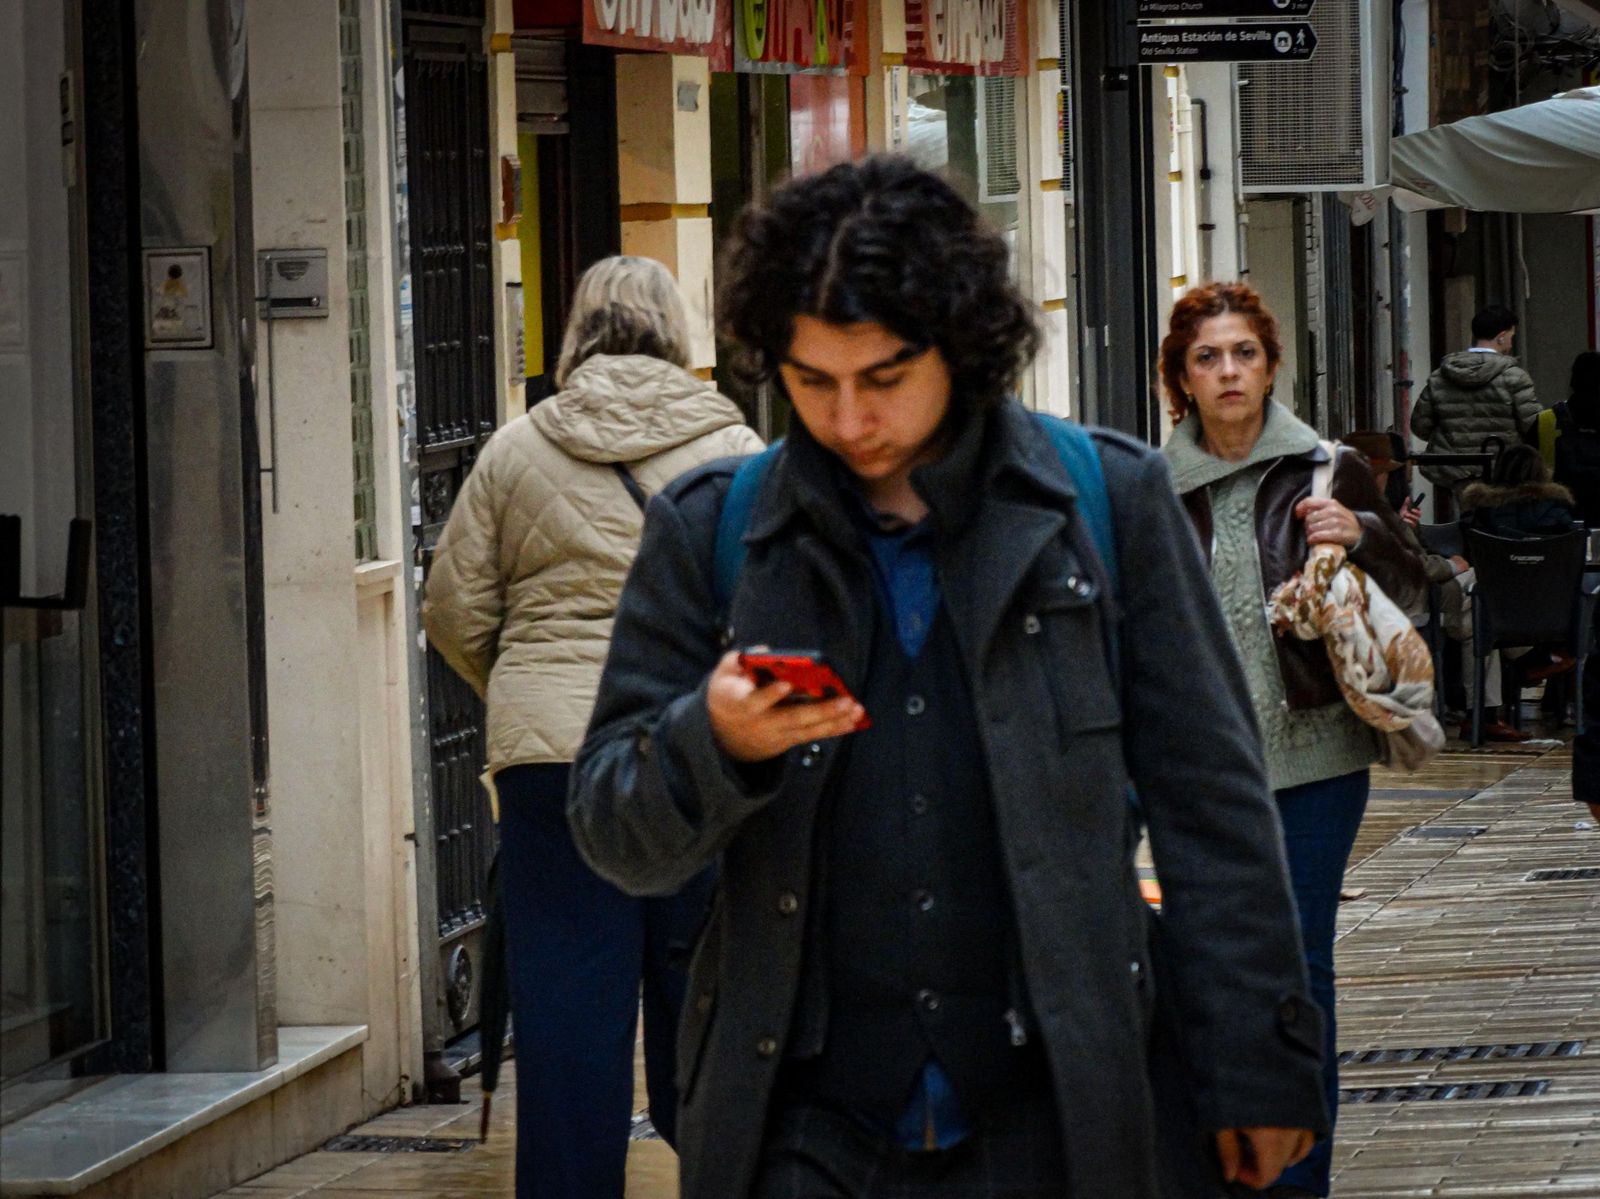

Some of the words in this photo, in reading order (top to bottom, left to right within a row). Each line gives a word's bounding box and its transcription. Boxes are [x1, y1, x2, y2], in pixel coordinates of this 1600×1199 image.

[1149, 3, 1179, 12] Milagrosa
[1181, 2, 1203, 10] Church
[1141, 33, 1180, 45] Antigua
[1182, 31, 1223, 42] Estación
[1225, 31, 1238, 41] de
[1240, 30, 1272, 41] Sevilla
[1154, 47, 1175, 55] Sevilla
[1176, 47, 1199, 55] Station
